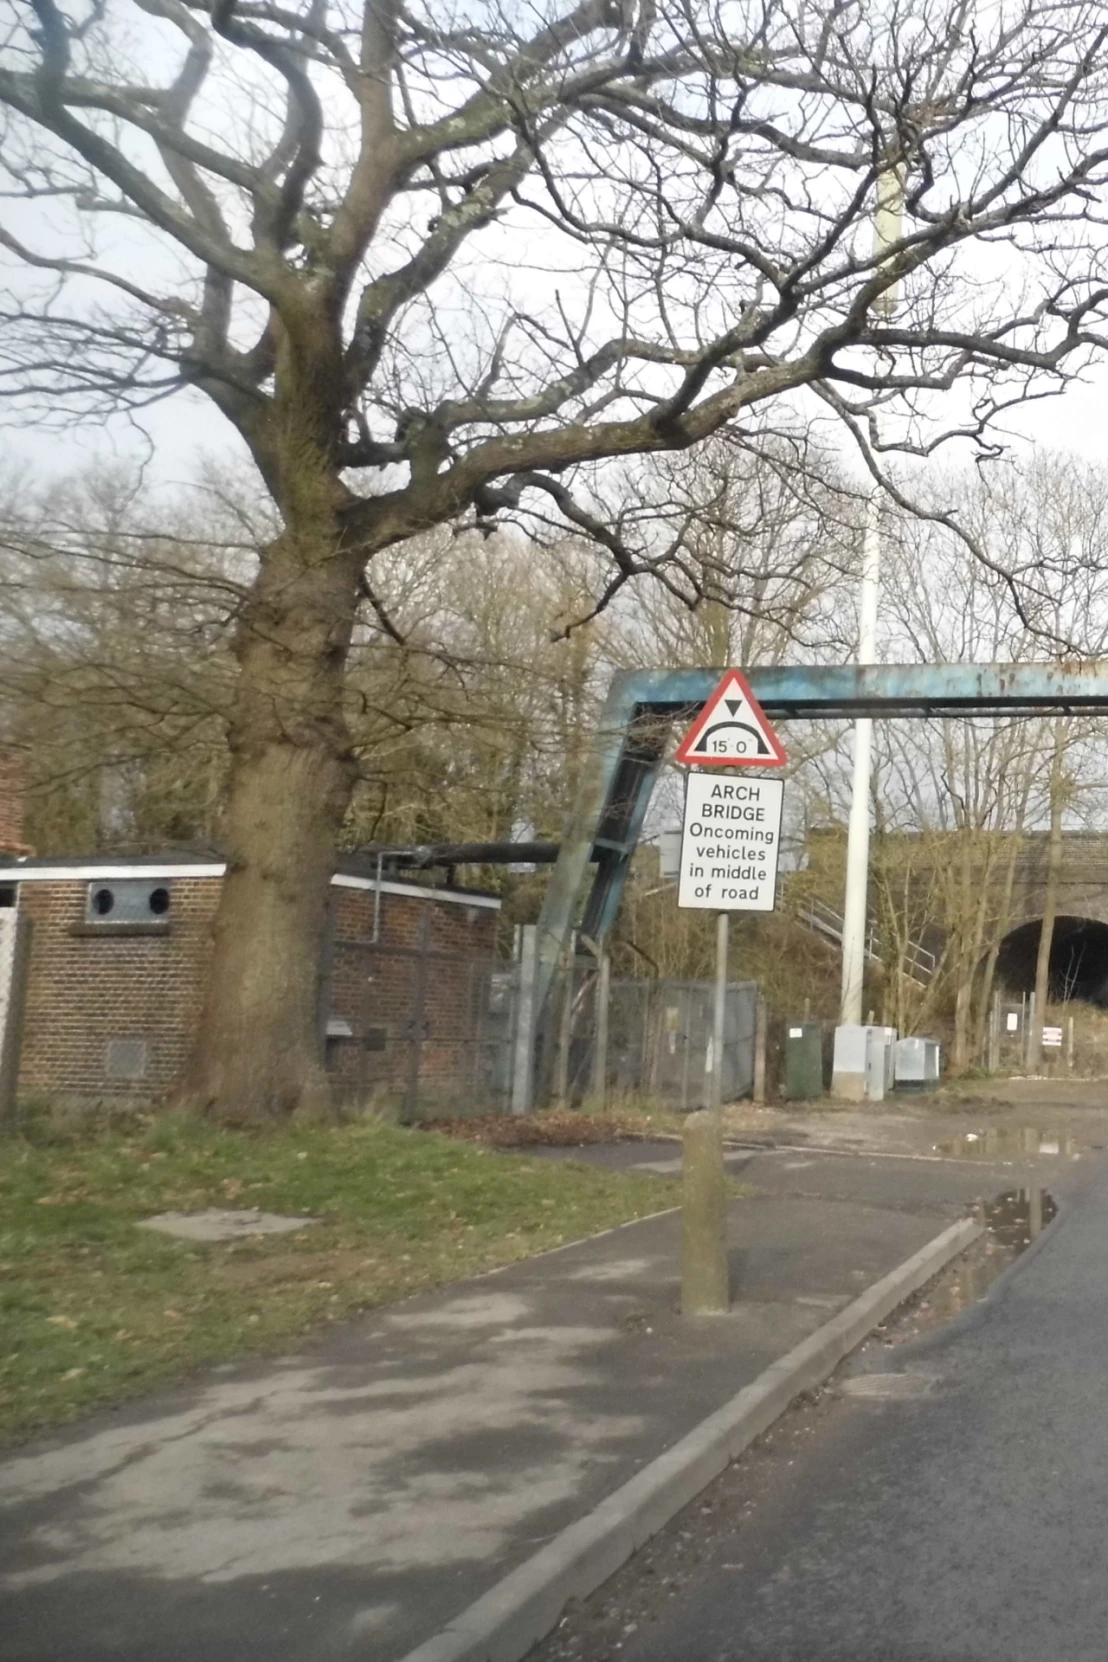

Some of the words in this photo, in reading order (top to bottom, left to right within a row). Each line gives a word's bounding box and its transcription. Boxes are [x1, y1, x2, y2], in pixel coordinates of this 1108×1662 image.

[711, 784, 760, 801] ARCH
[701, 803, 765, 822] BRIDGE
[690, 822, 774, 845] Oncoming
[696, 845, 766, 861] vehicles
[690, 863, 704, 877] in
[711, 865, 767, 881] middle
[695, 884, 711, 898] of
[721, 886, 759, 900] road
